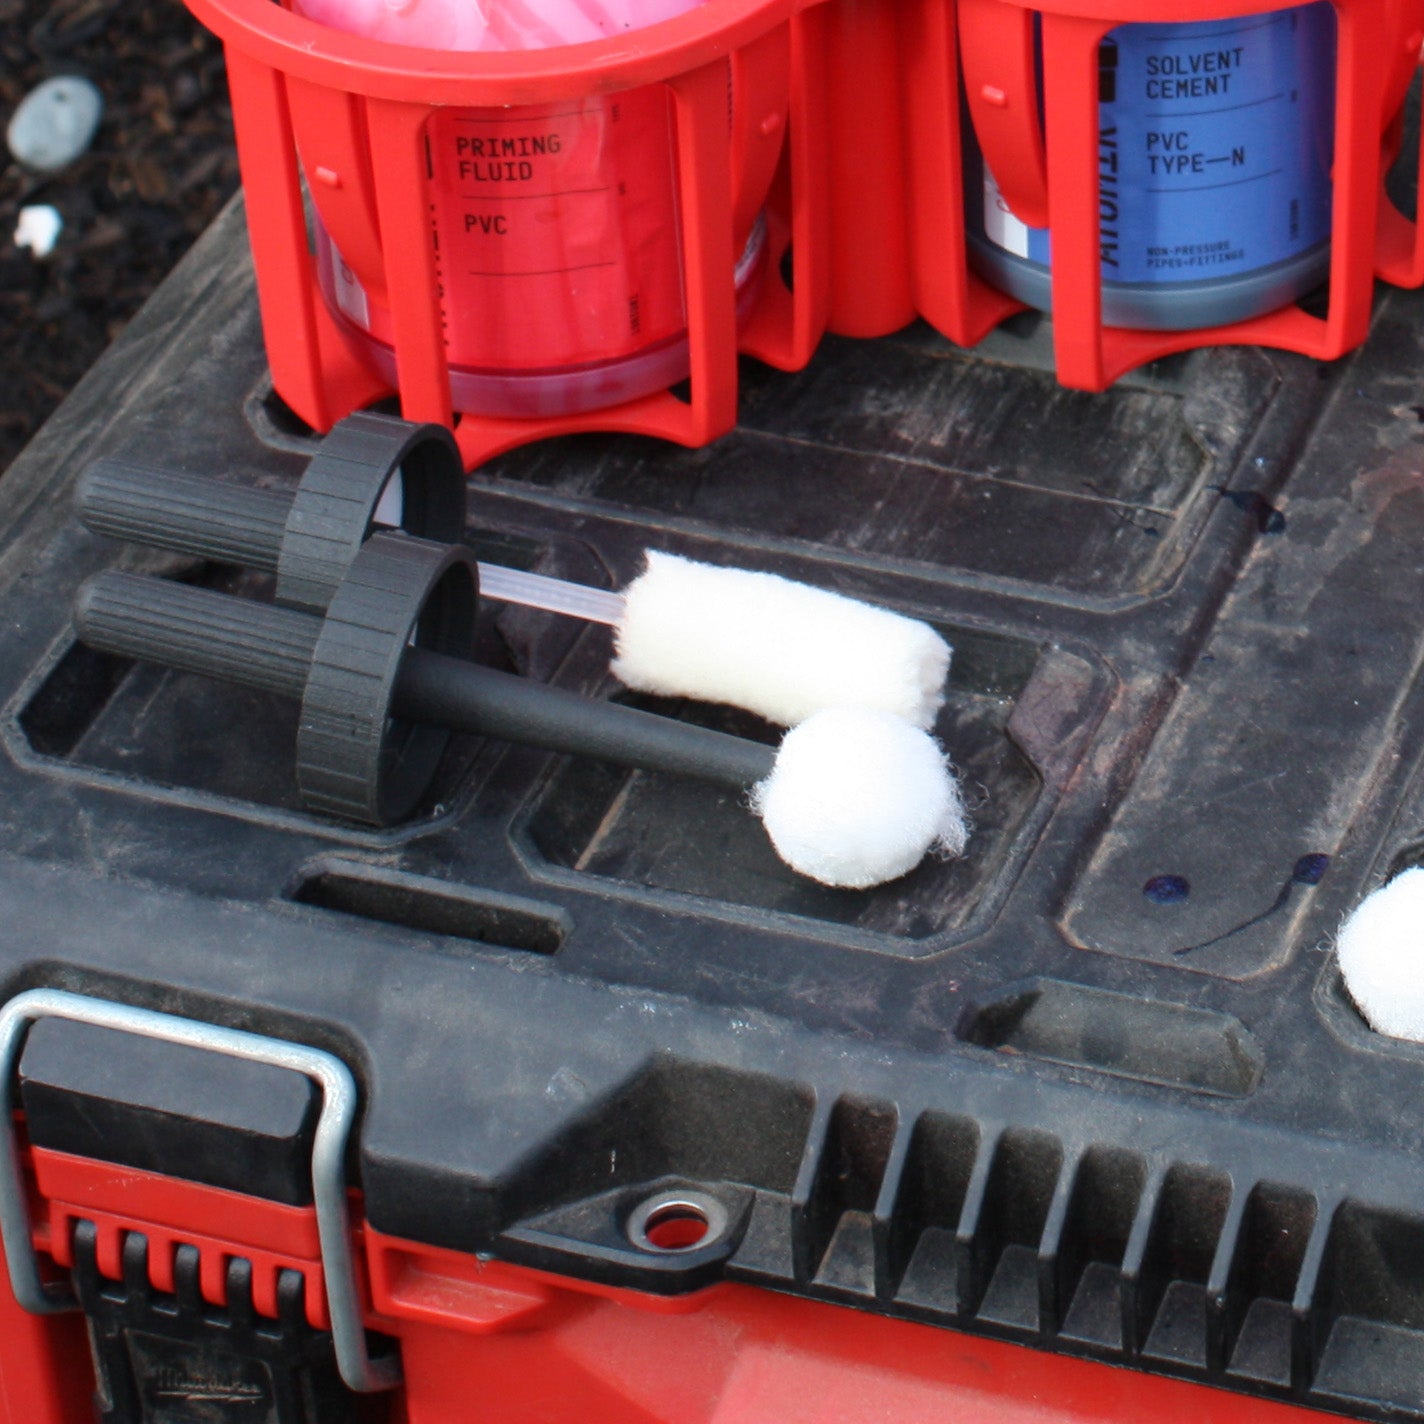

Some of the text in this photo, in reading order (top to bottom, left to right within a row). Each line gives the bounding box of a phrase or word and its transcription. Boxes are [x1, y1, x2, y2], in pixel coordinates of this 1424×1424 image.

[1145, 47, 1244, 76] SOLVENT
[1145, 74, 1231, 100] CEMENT
[456, 134, 562, 157] PRIMING
[1147, 131, 1188, 152] PVC
[459, 160, 532, 181] FLUID
[464, 214, 508, 235] PVC
